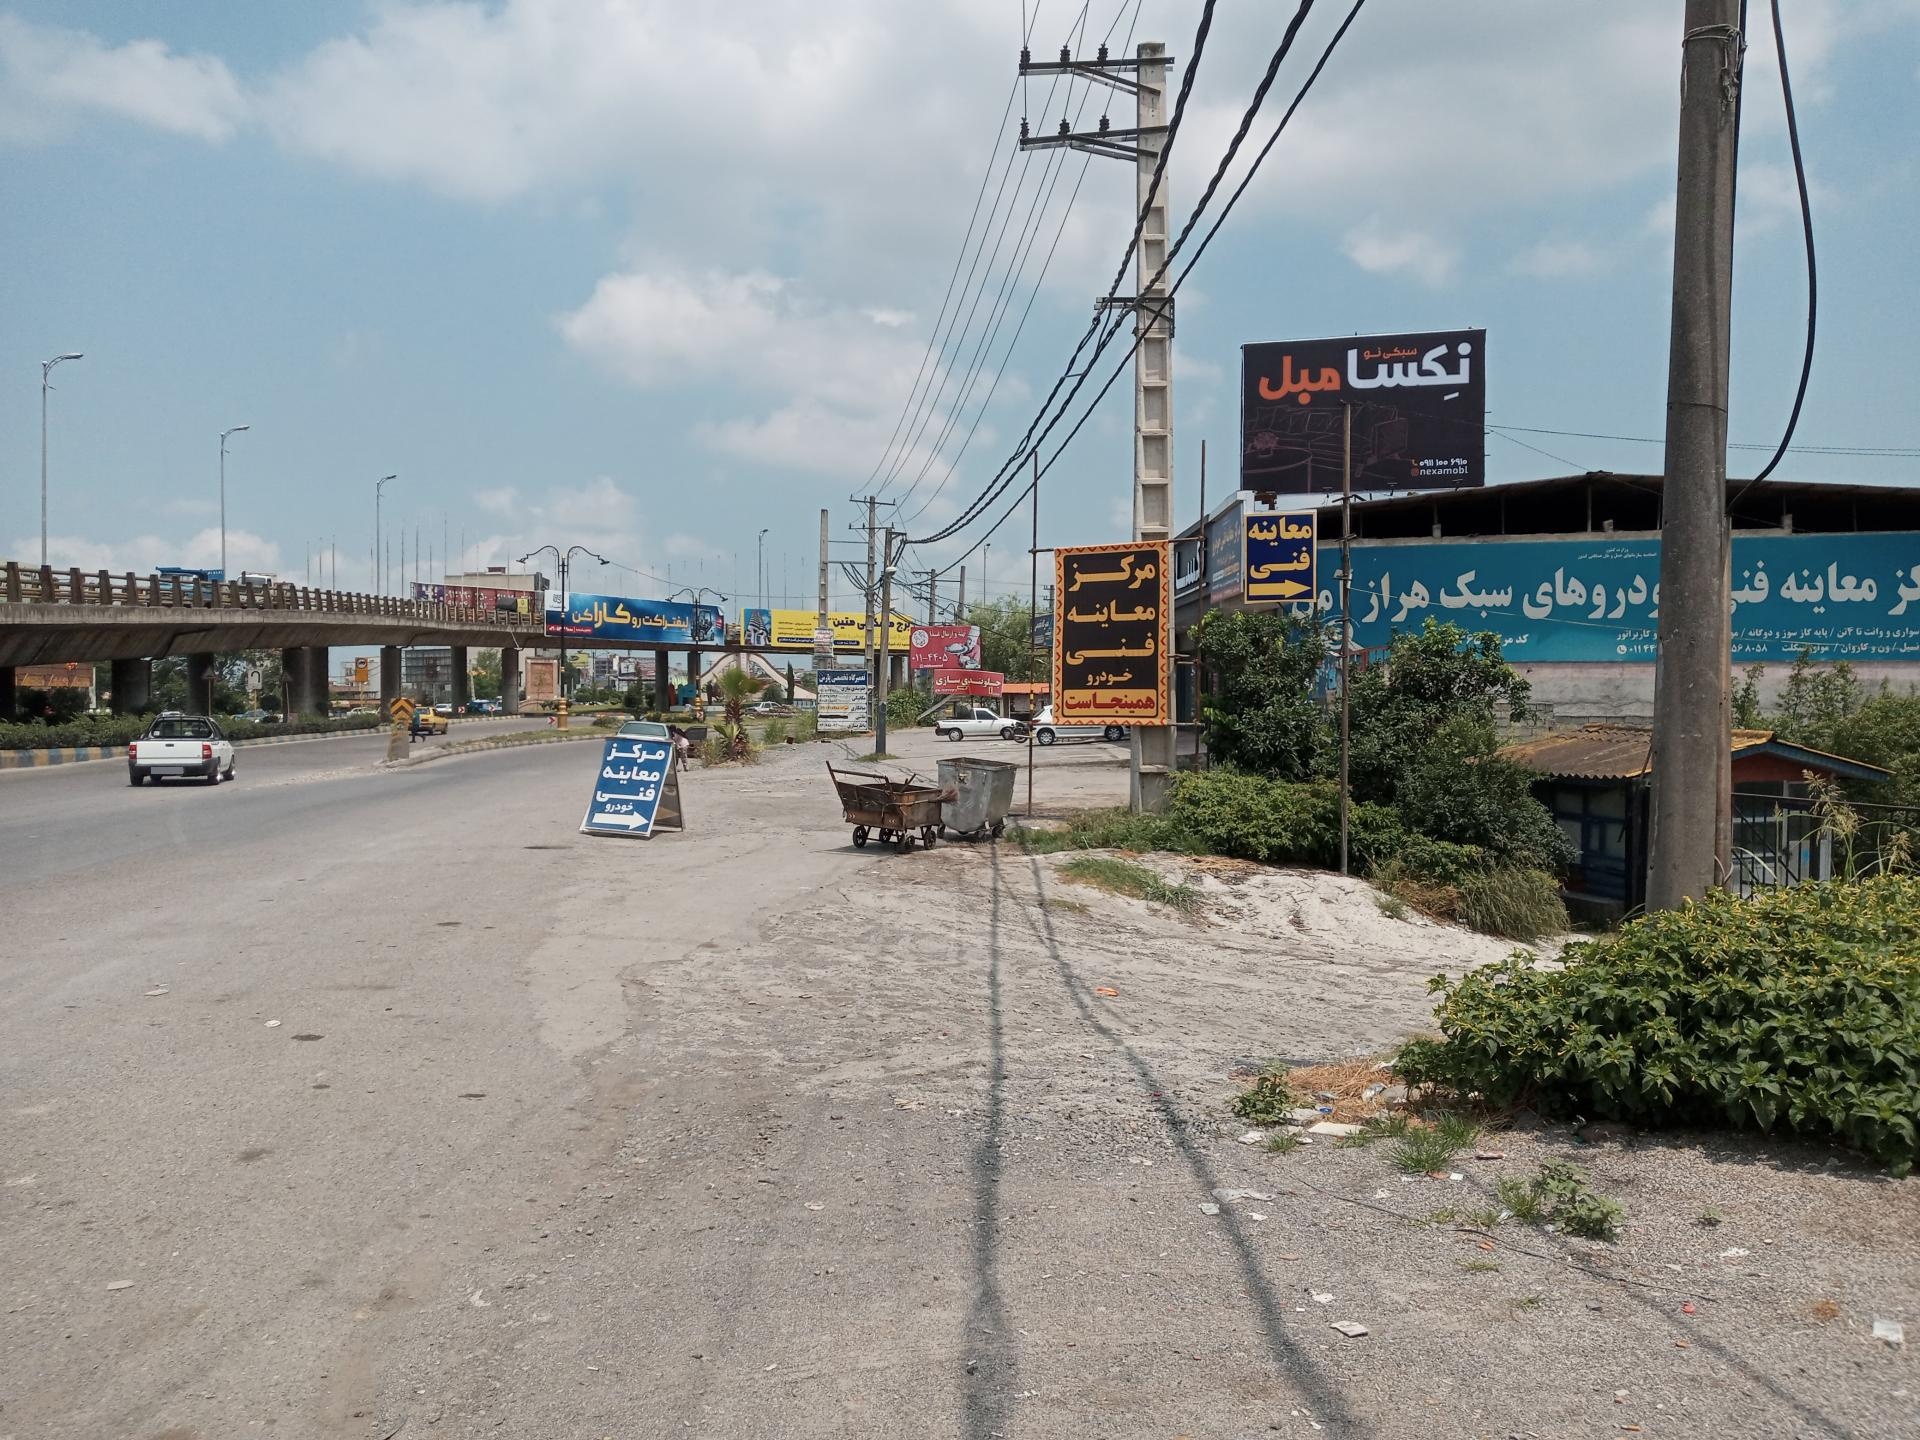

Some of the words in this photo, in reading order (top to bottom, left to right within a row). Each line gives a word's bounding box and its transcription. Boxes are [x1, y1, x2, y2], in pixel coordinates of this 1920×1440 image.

[1364, 347, 1381, 360] نو
[1258, 355, 1341, 405] مبل
[1420, 466, 1468, 475] nexamobl
[1248, 517, 1312, 546] معاینه
[1250, 546, 1310, 579] فنی
[1068, 554, 1156, 592] مرکز
[1362, 572, 1430, 622] هراز
[1440, 570, 1513, 618] سبک
[1780, 561, 1878, 614] معاینه
[632, 615, 641, 628] رو
[642, 614, 689, 631] لیفتراکت
[1067, 600, 1156, 628] معاینه
[1616, 629, 1651, 641] کاربراتور
[1065, 632, 1155, 665] فنی
[936, 675, 960, 686] سازی
[1086, 668, 1133, 686] خودرو
[1065, 691, 1155, 714] همینجاست
[606, 743, 665, 763] مرکز
[602, 766, 660, 784] معاینه
[596, 783, 656, 802] فنی
[605, 802, 633, 813] خودرو
